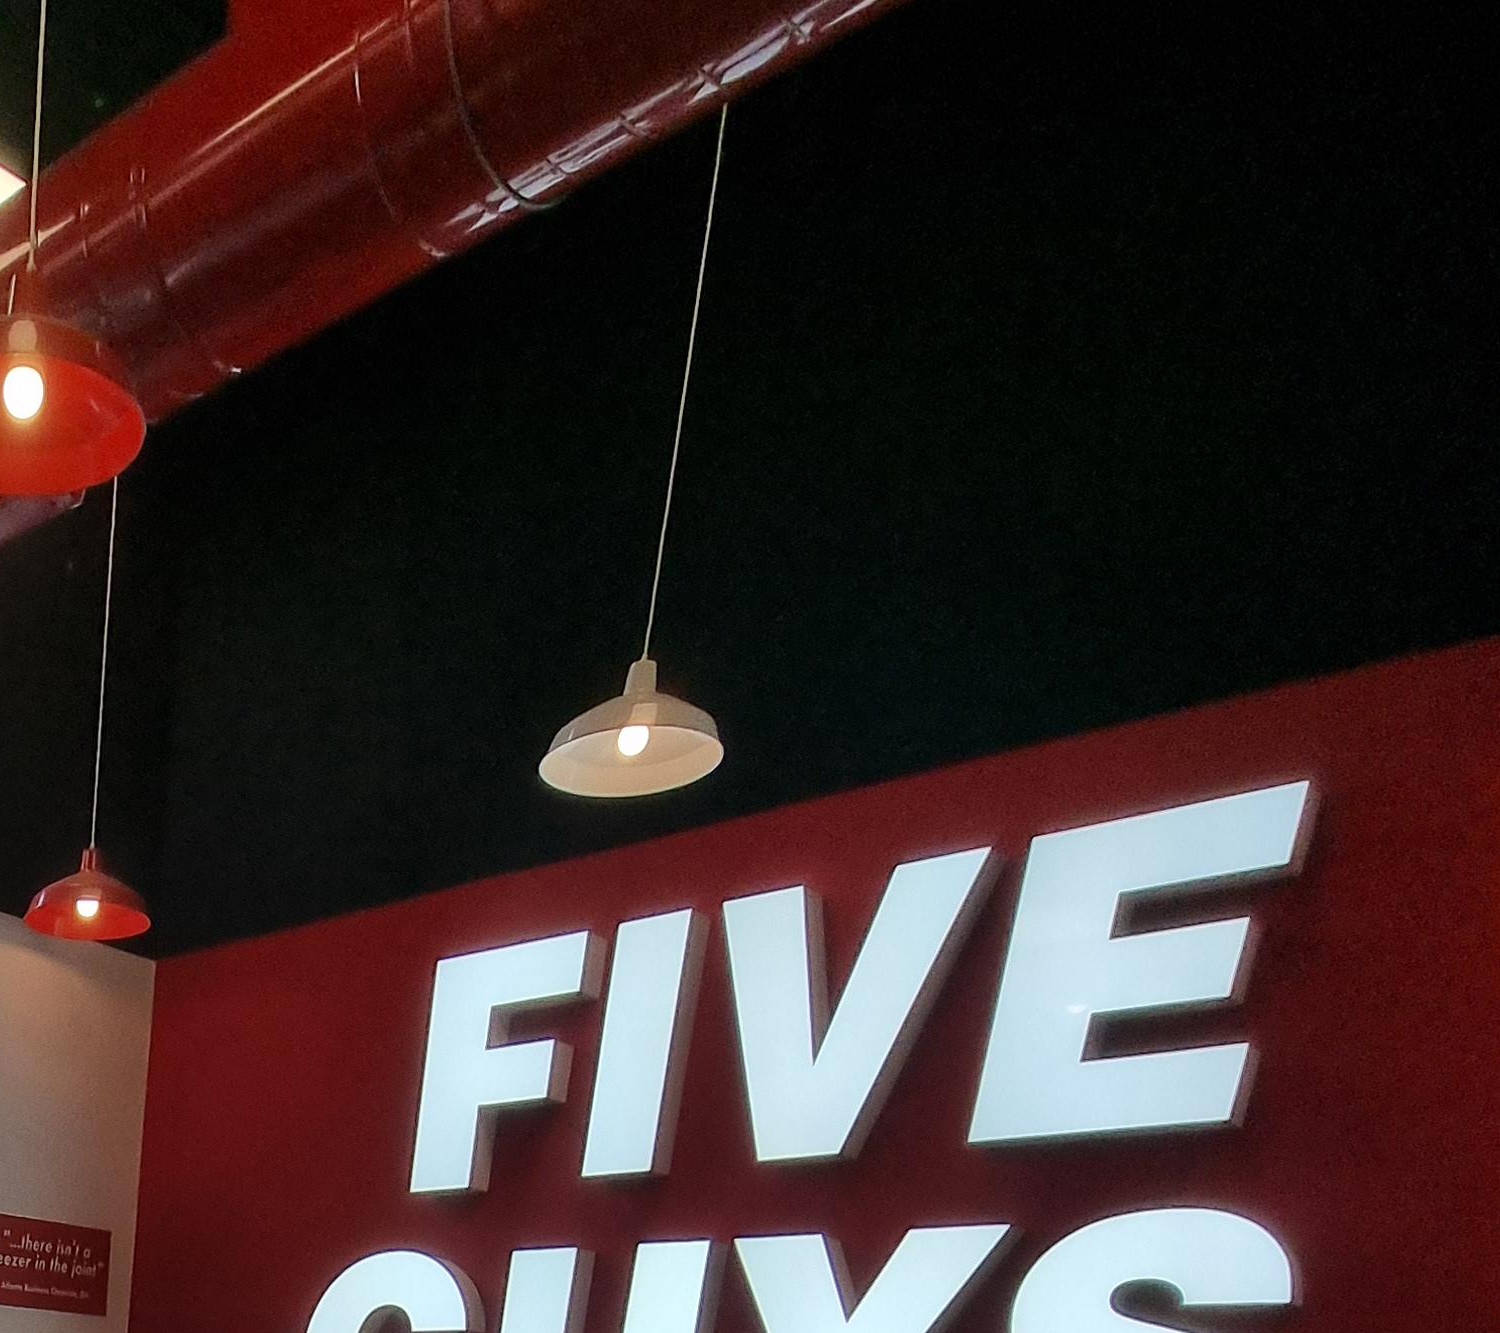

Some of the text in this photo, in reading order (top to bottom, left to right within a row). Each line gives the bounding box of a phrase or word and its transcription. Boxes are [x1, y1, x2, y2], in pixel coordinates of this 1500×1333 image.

[408, 780, 1315, 1195] FIVE
[56, 1239, 80, 1257] isn't
[83, 1248, 91, 1259] a
[35, 1254, 46, 1271] in
[50, 1256, 68, 1273] the
